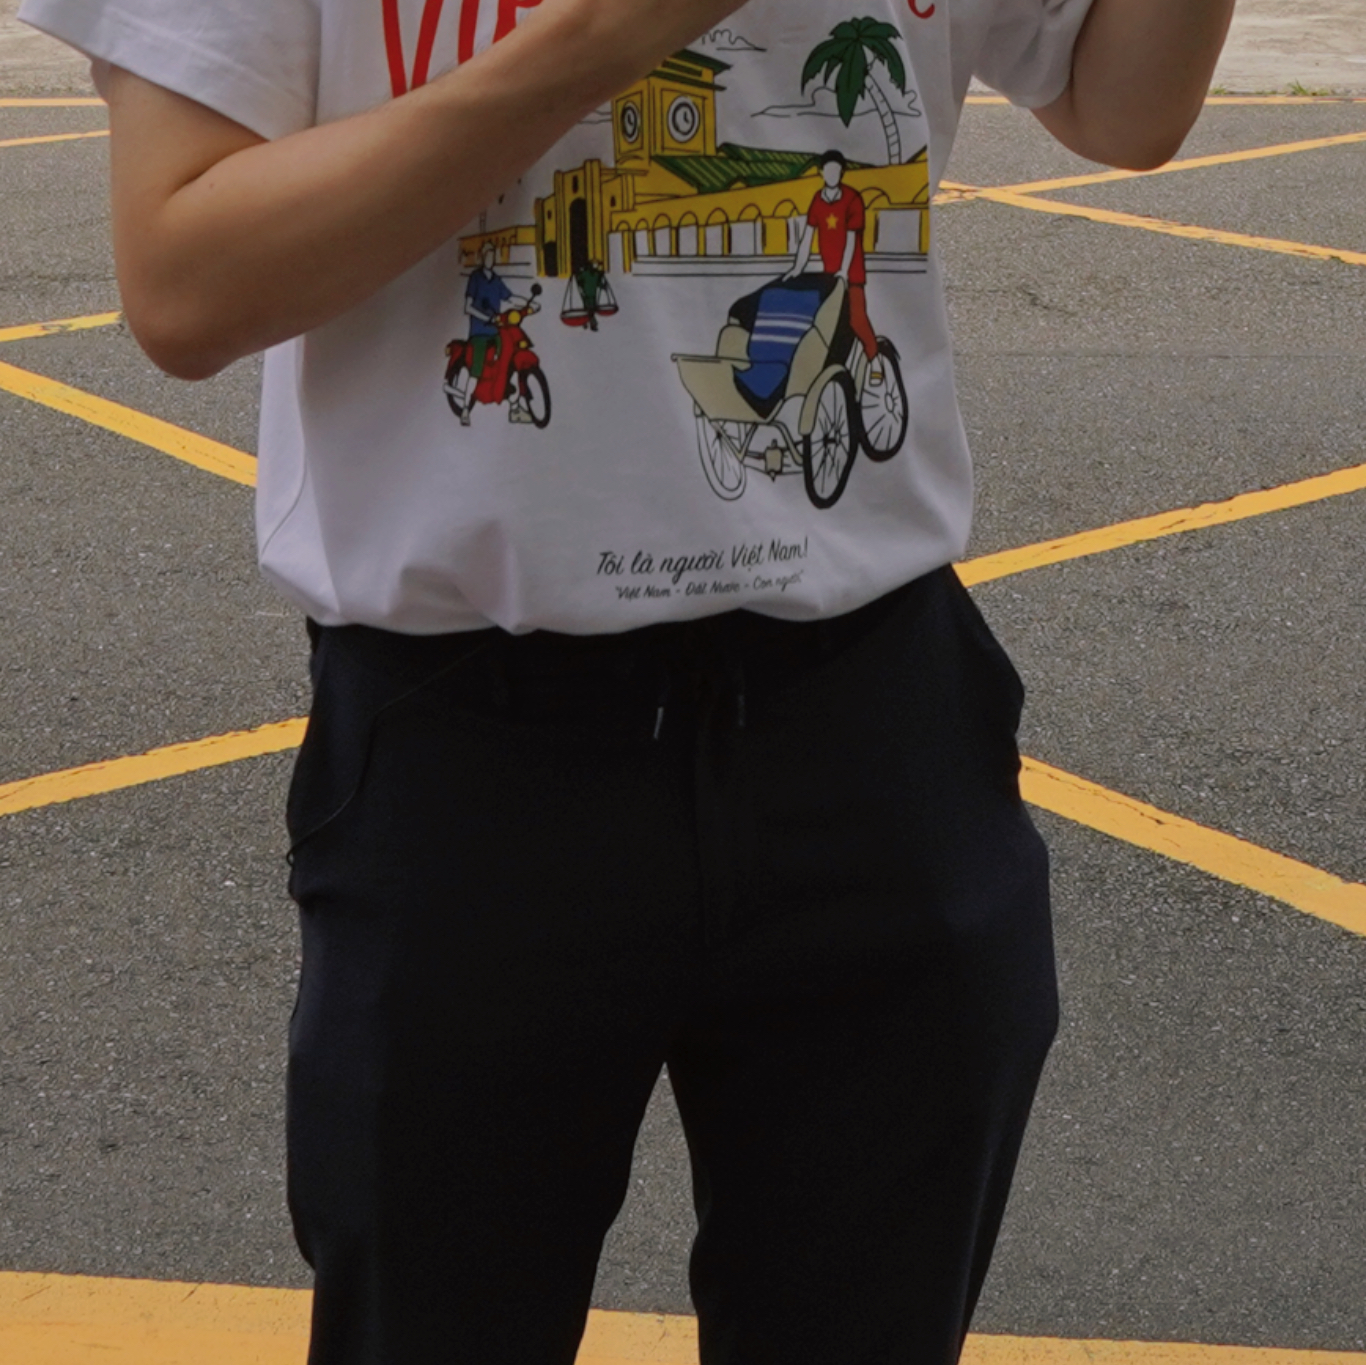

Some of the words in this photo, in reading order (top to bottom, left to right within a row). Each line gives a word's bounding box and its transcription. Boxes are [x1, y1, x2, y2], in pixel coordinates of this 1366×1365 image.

[597, 551, 624, 575] Tôi
[631, 550, 654, 574] là
[659, 549, 724, 585] người
[731, 542, 764, 572] Việt
[767, 536, 808, 562] Nam!
[644, 585, 671, 598] Nam
[753, 575, 773, 591] Con
